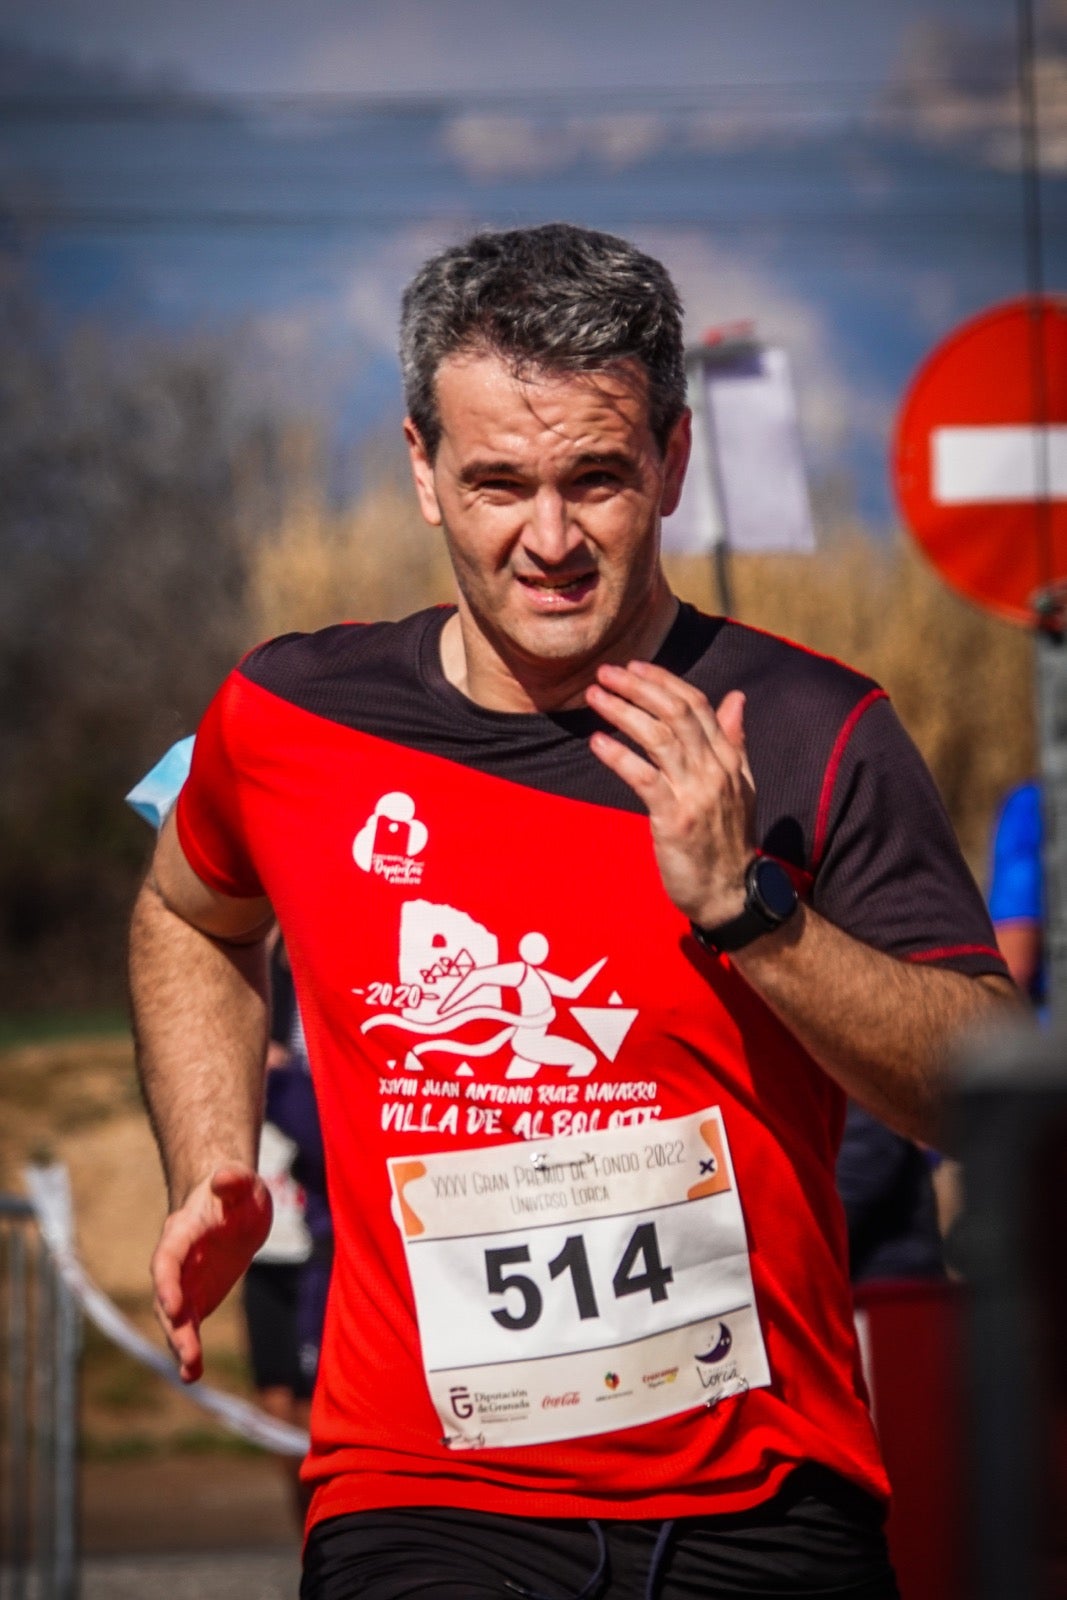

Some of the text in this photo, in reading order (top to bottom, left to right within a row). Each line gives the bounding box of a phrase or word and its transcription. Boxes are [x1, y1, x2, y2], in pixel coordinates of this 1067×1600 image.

[421, 1079, 460, 1098] JUAN
[465, 1082, 533, 1105] ANTONIO
[537, 1084, 579, 1105] RUIZ
[584, 1081, 657, 1102] NAVARRO
[381, 1102, 459, 1135] VILLA
[466, 1106, 502, 1135] DE
[472, 1170, 510, 1195] GRAN
[643, 1140, 686, 1169] 2022
[510, 1185, 611, 1215] UNIVERSO LORCA
[484, 1221, 675, 1331] 514
[474, 1389, 528, 1403] Diputación
[488, 1400, 530, 1413] Granada
